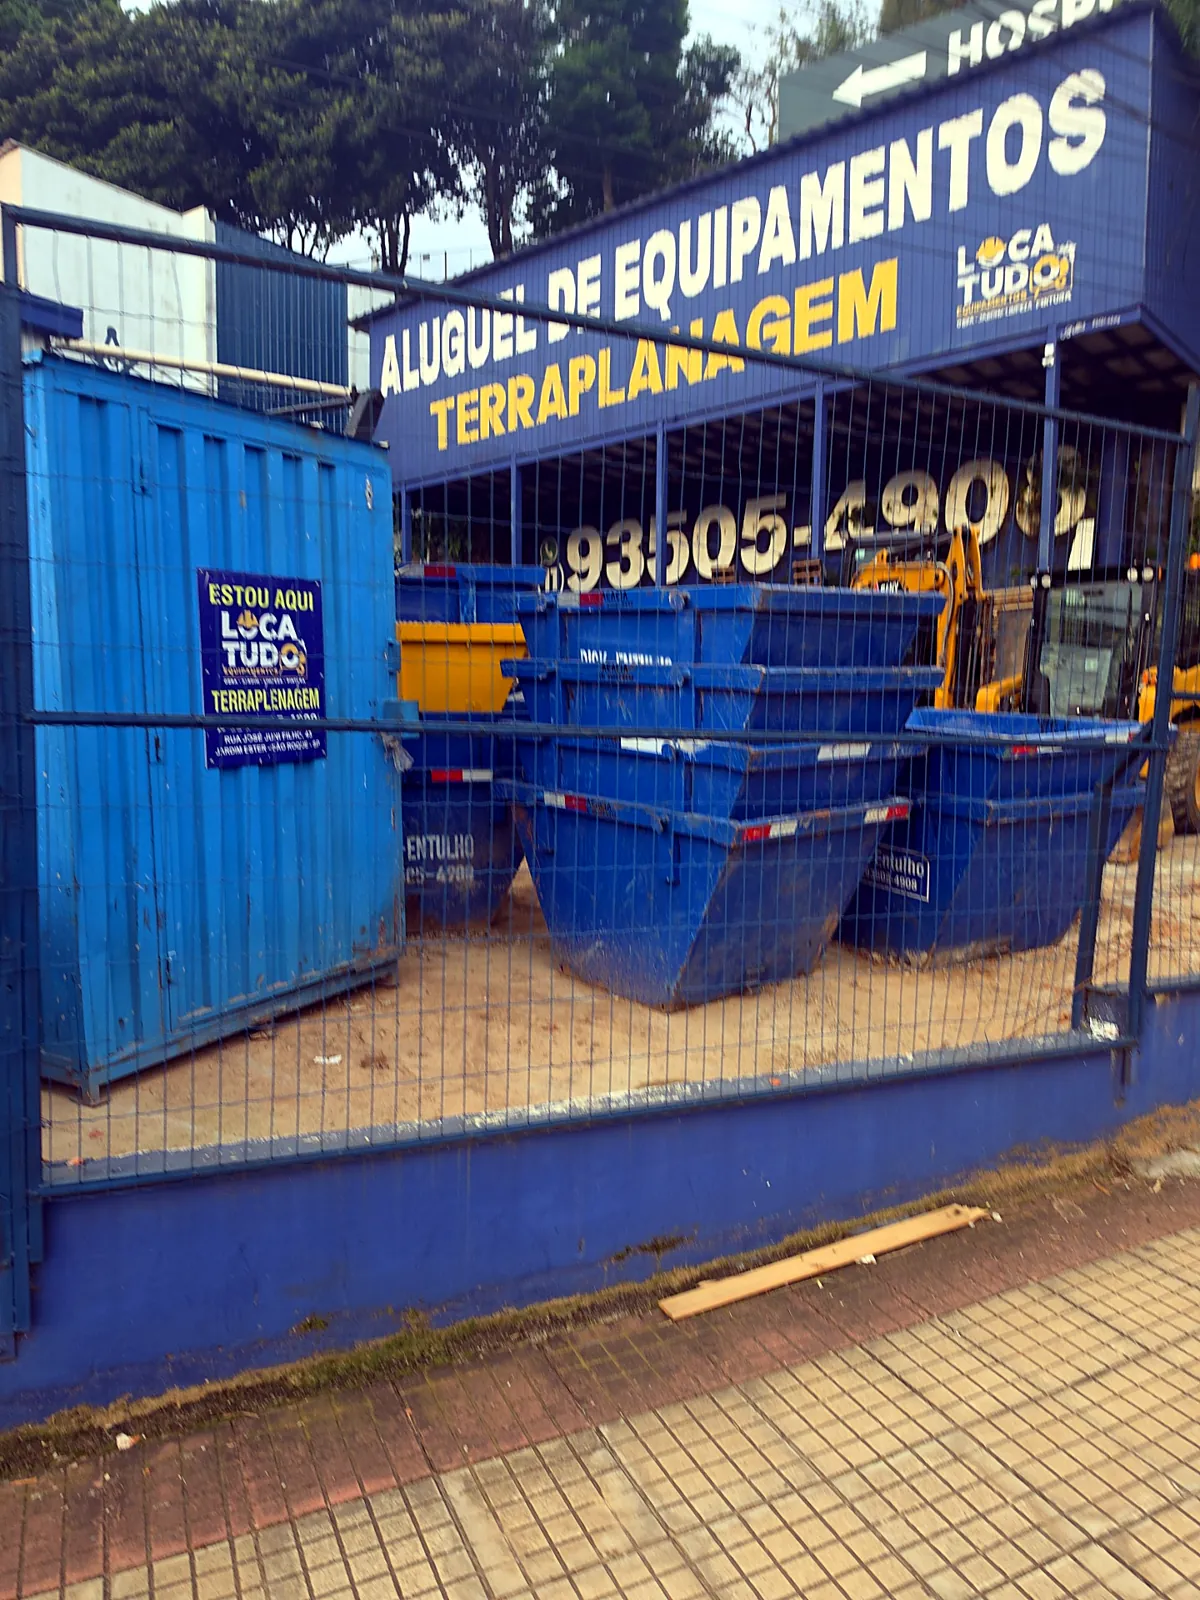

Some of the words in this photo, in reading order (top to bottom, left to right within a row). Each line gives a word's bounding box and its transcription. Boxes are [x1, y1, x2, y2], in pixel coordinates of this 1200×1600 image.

[381, 284, 537, 398] ALUGUEL
[548, 253, 601, 344] DE
[614, 69, 1106, 323] EQUIPAMENTOS
[957, 222, 1054, 276] LOCA
[957, 254, 1060, 307] TUDO
[430, 257, 898, 451] TERRAPLANAGEM
[208, 583, 269, 609] ESTOU
[274, 589, 314, 612] AQUI
[221, 609, 297, 641] LOCA
[222, 641, 300, 668] TUDO
[406, 833, 474, 861] ENTULHO
